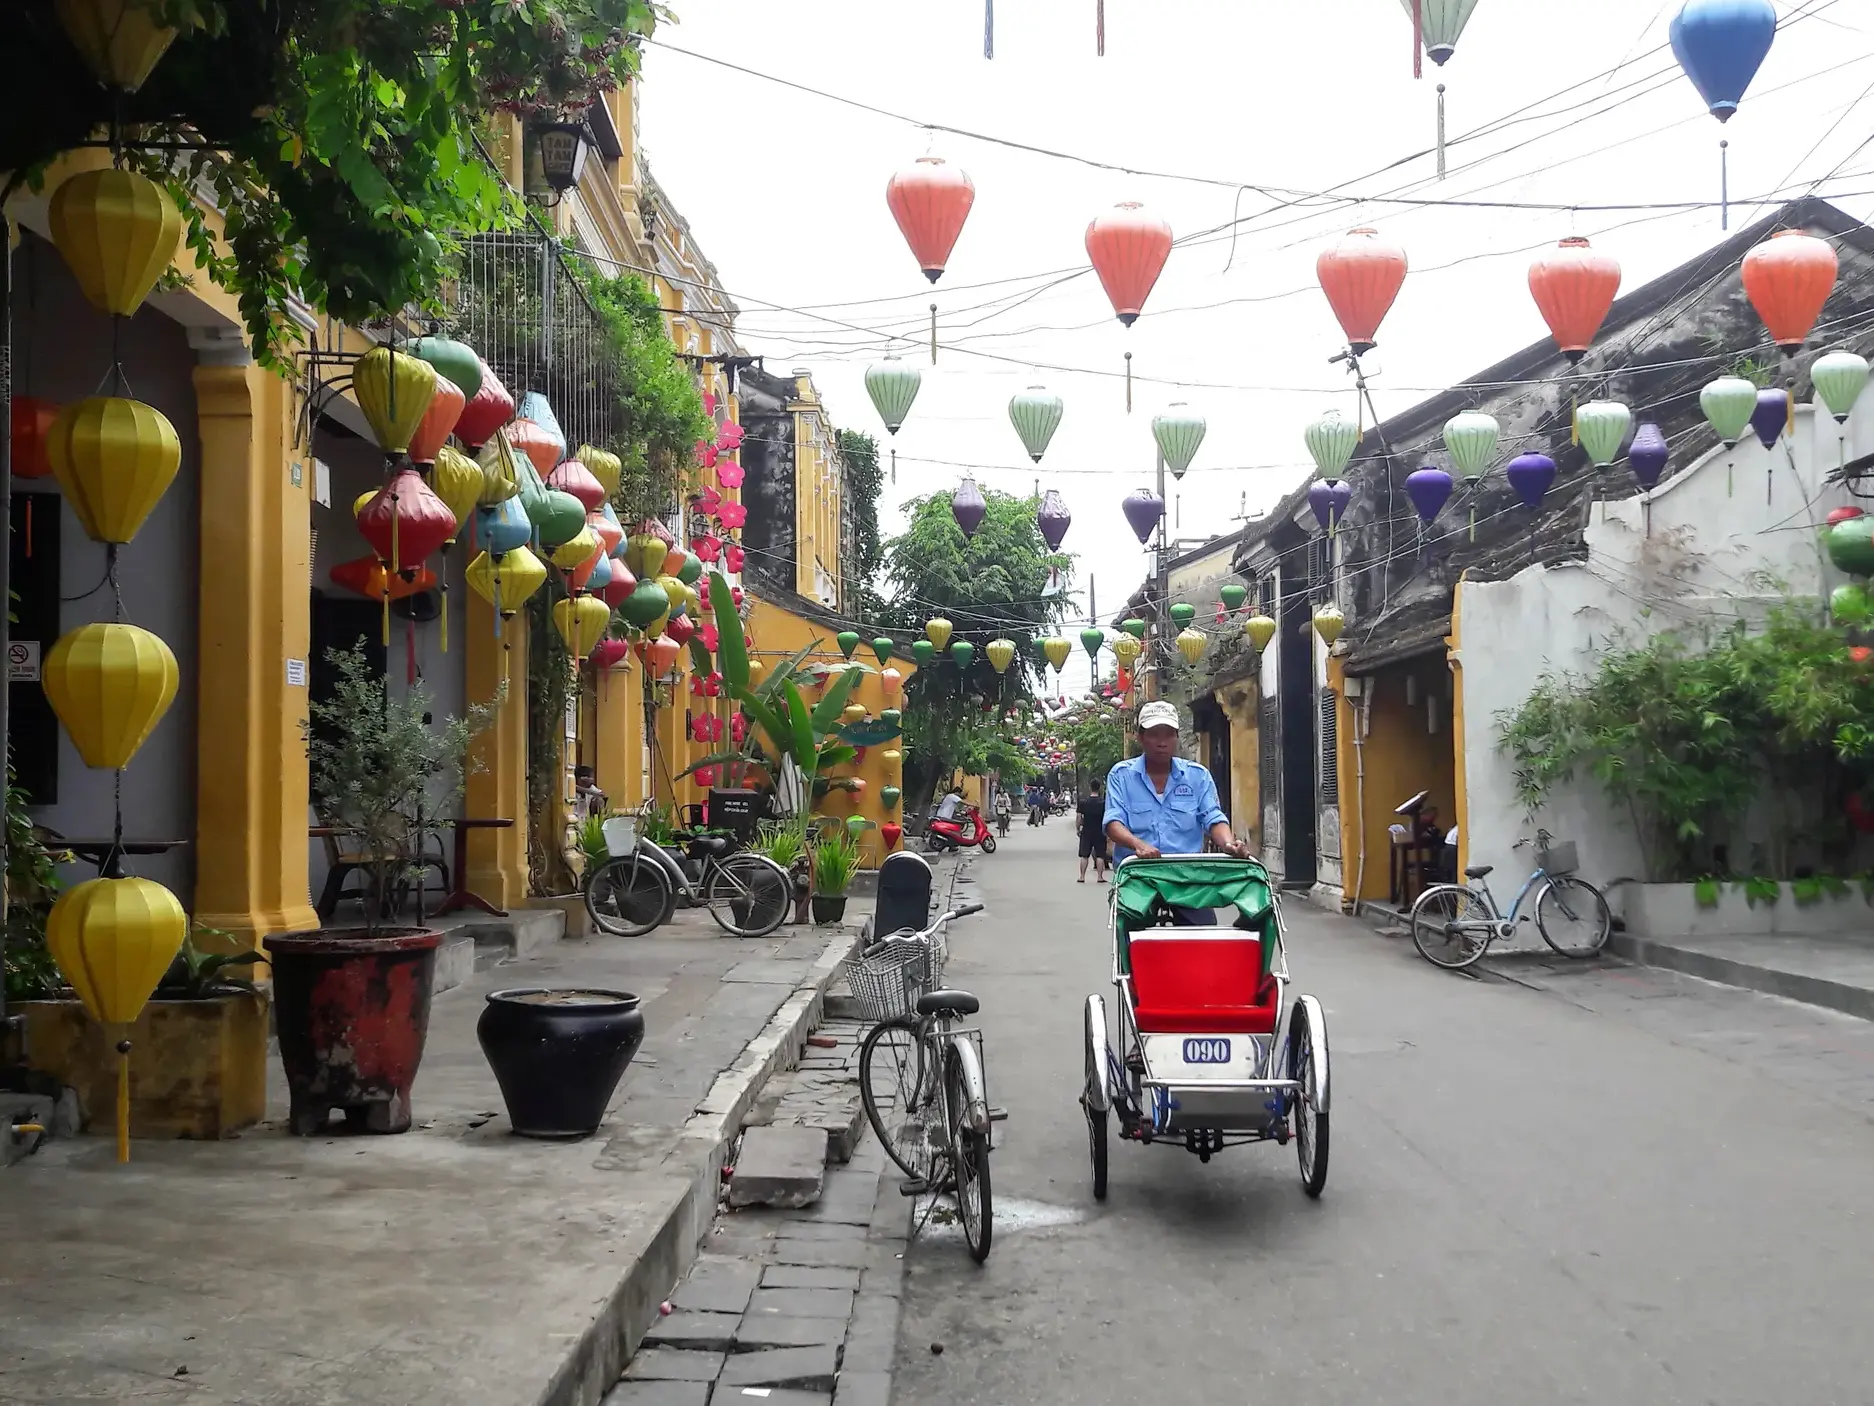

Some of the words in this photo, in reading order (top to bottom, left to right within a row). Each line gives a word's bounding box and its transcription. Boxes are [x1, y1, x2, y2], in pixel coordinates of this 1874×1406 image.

[547, 136, 572, 149] TAM
[547, 150, 572, 161] TAM
[1186, 1040, 1228, 1061] 090
